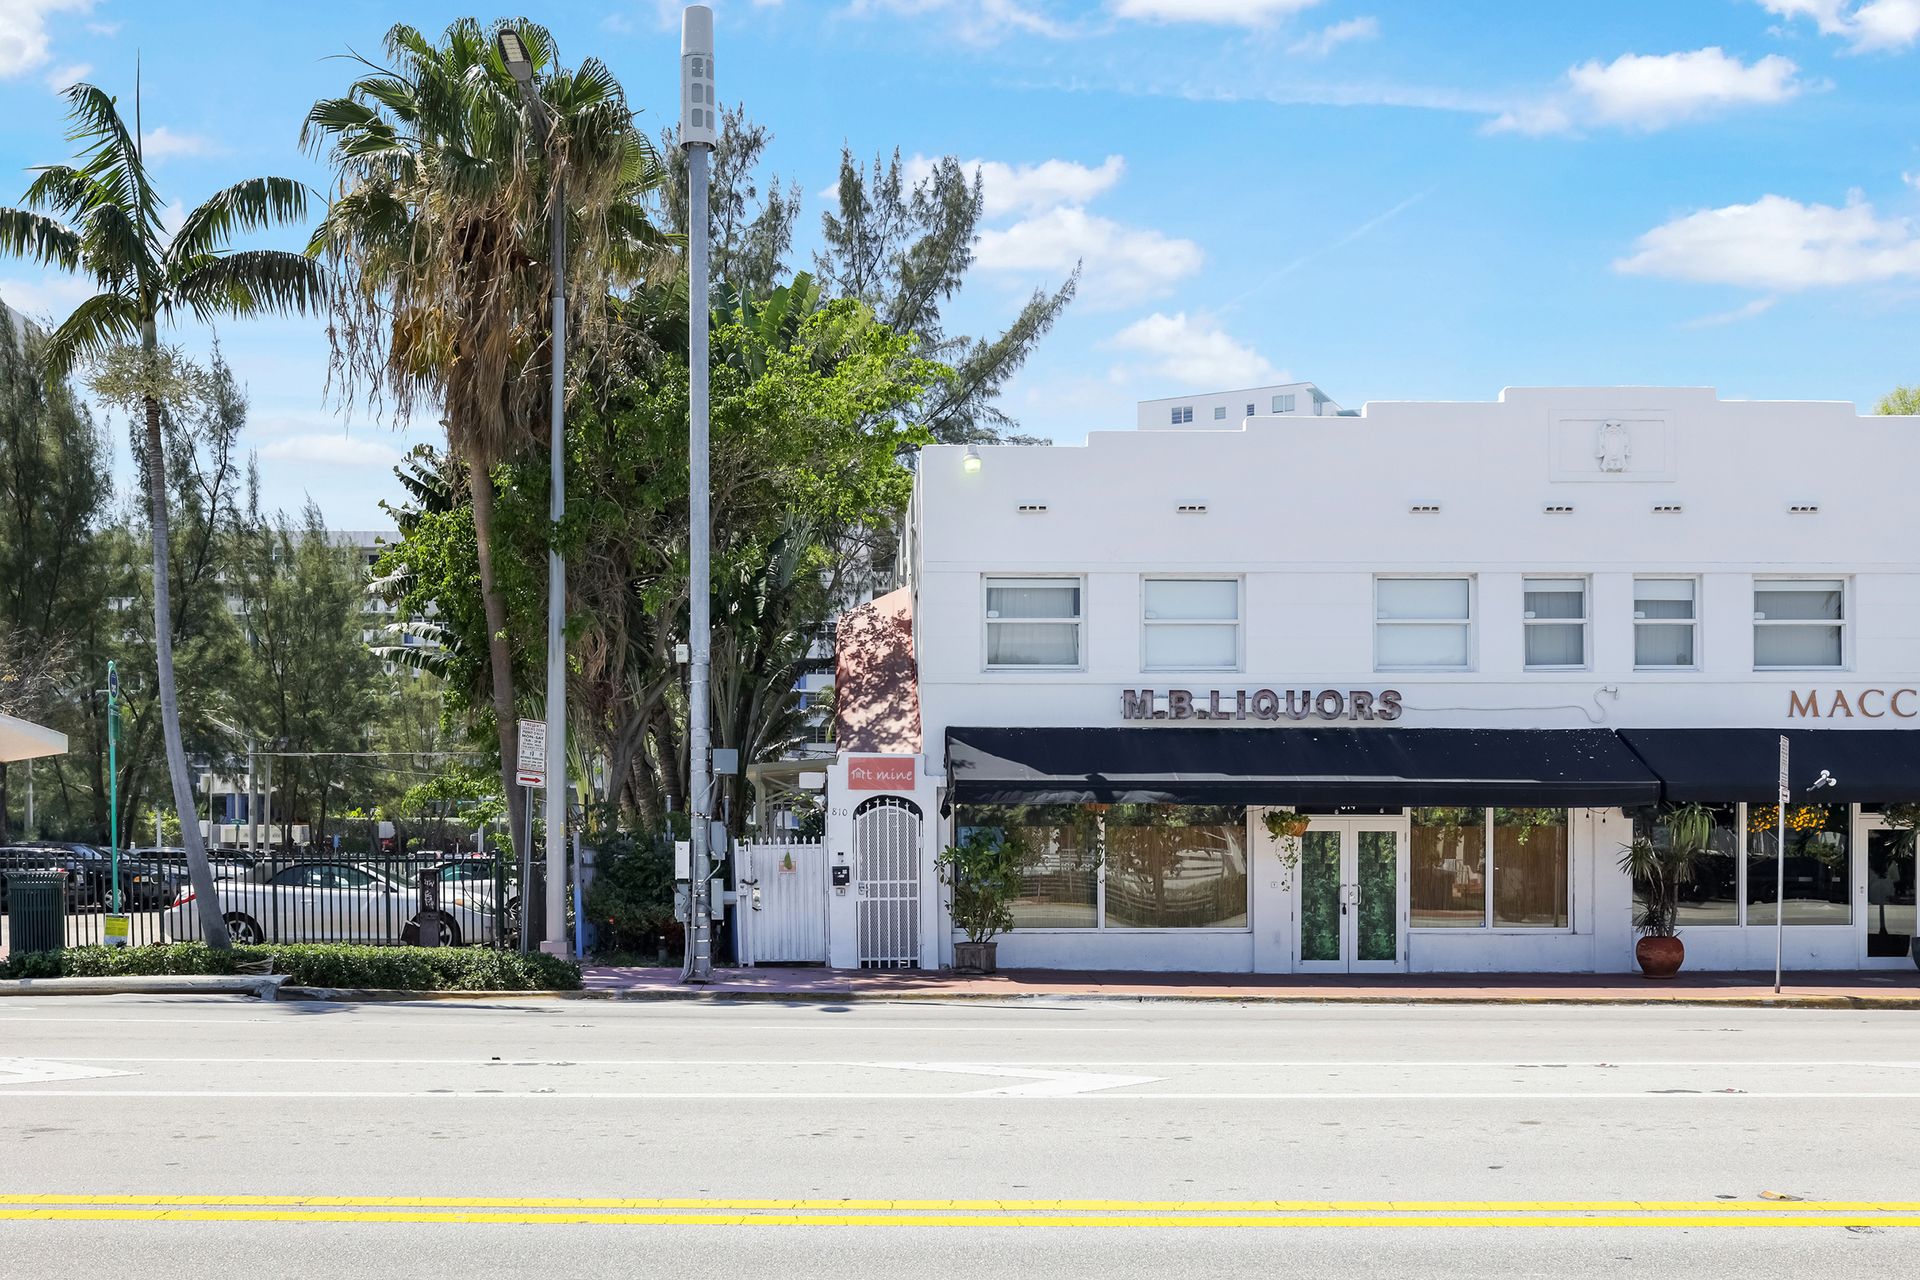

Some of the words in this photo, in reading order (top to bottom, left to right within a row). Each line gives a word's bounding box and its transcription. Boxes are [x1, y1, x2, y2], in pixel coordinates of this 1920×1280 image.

[1787, 688, 1918, 718] MACC
[876, 768, 913, 780] mine
[832, 808, 848, 816] 810
